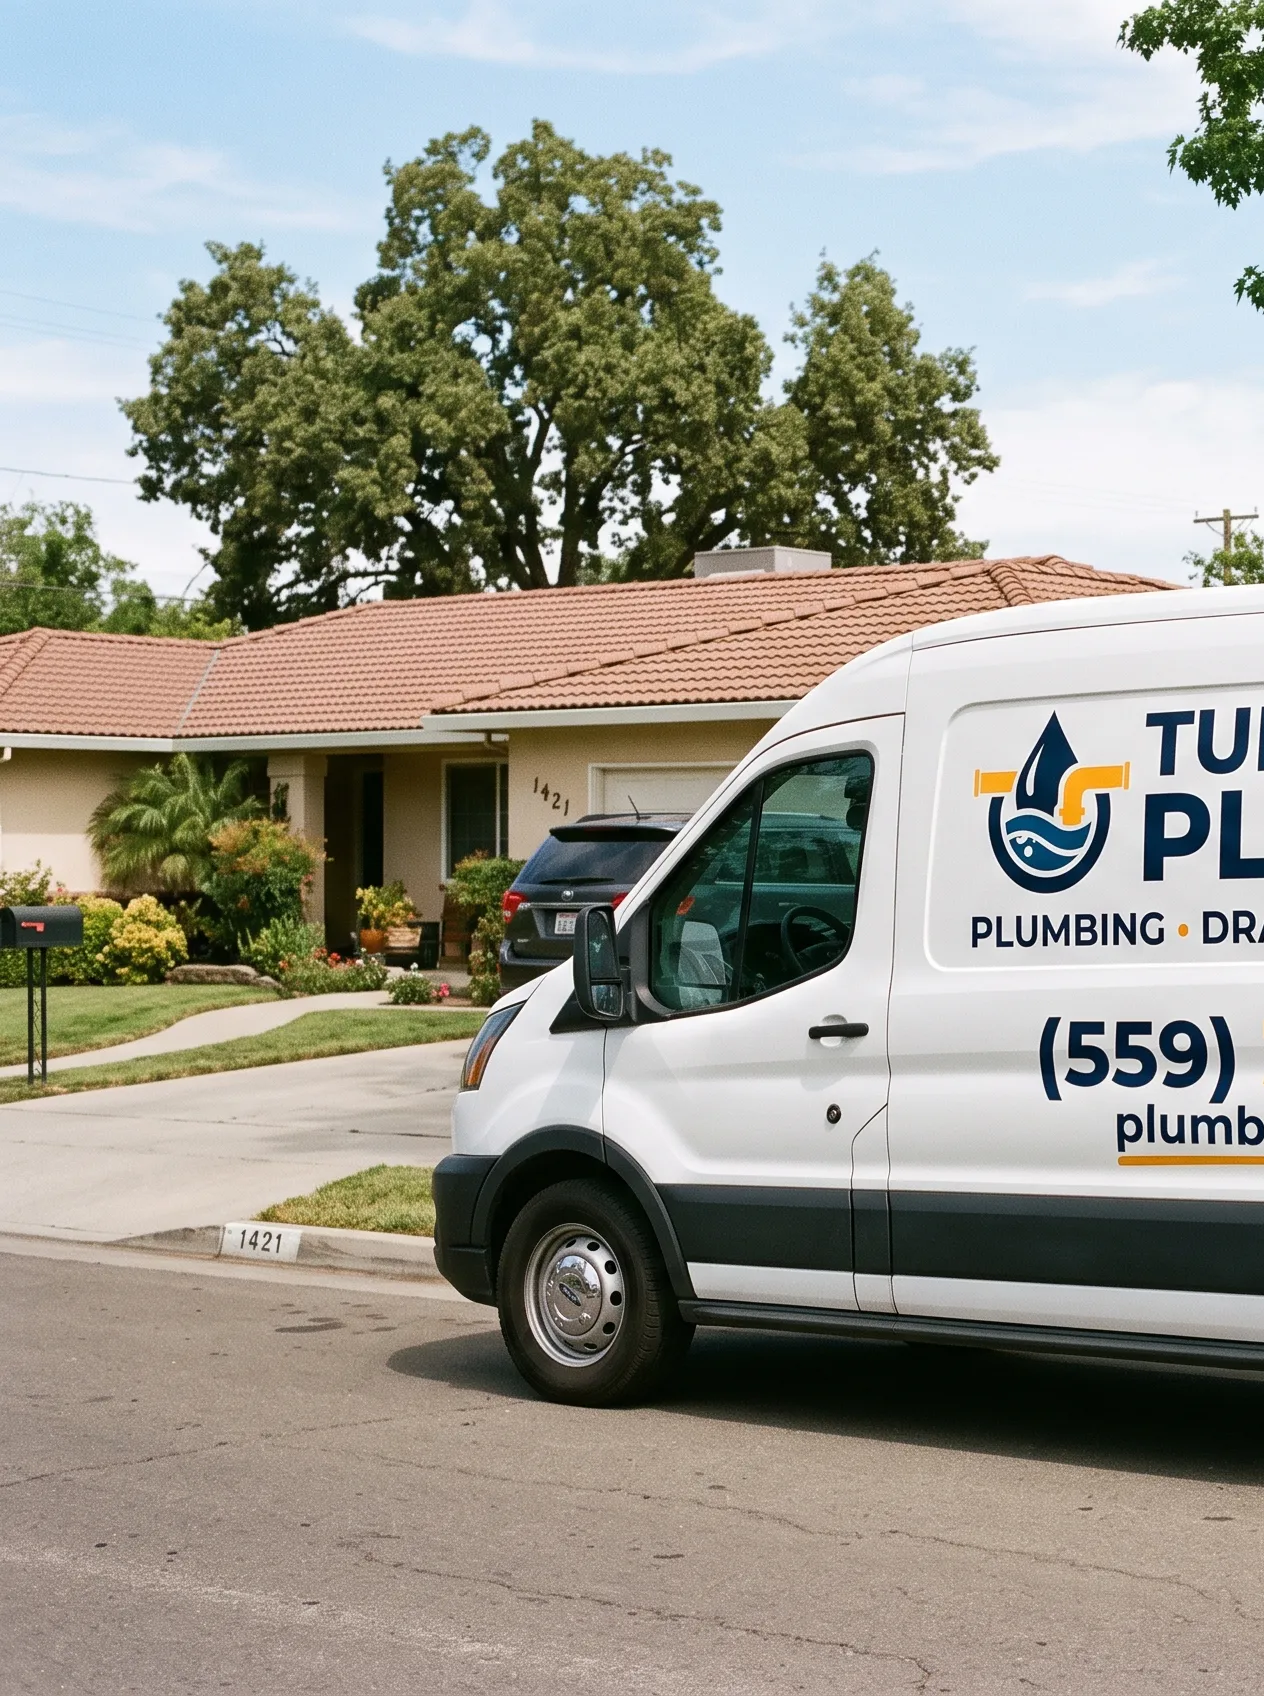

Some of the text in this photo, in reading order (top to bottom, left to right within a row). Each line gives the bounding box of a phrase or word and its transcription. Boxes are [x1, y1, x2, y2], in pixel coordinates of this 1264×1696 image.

[533, 775, 570, 817] 1421
[971, 911, 1165, 949] PLUMBING
[1038, 1015, 1237, 1102] (559)
[240, 1228, 283, 1254] 1421
